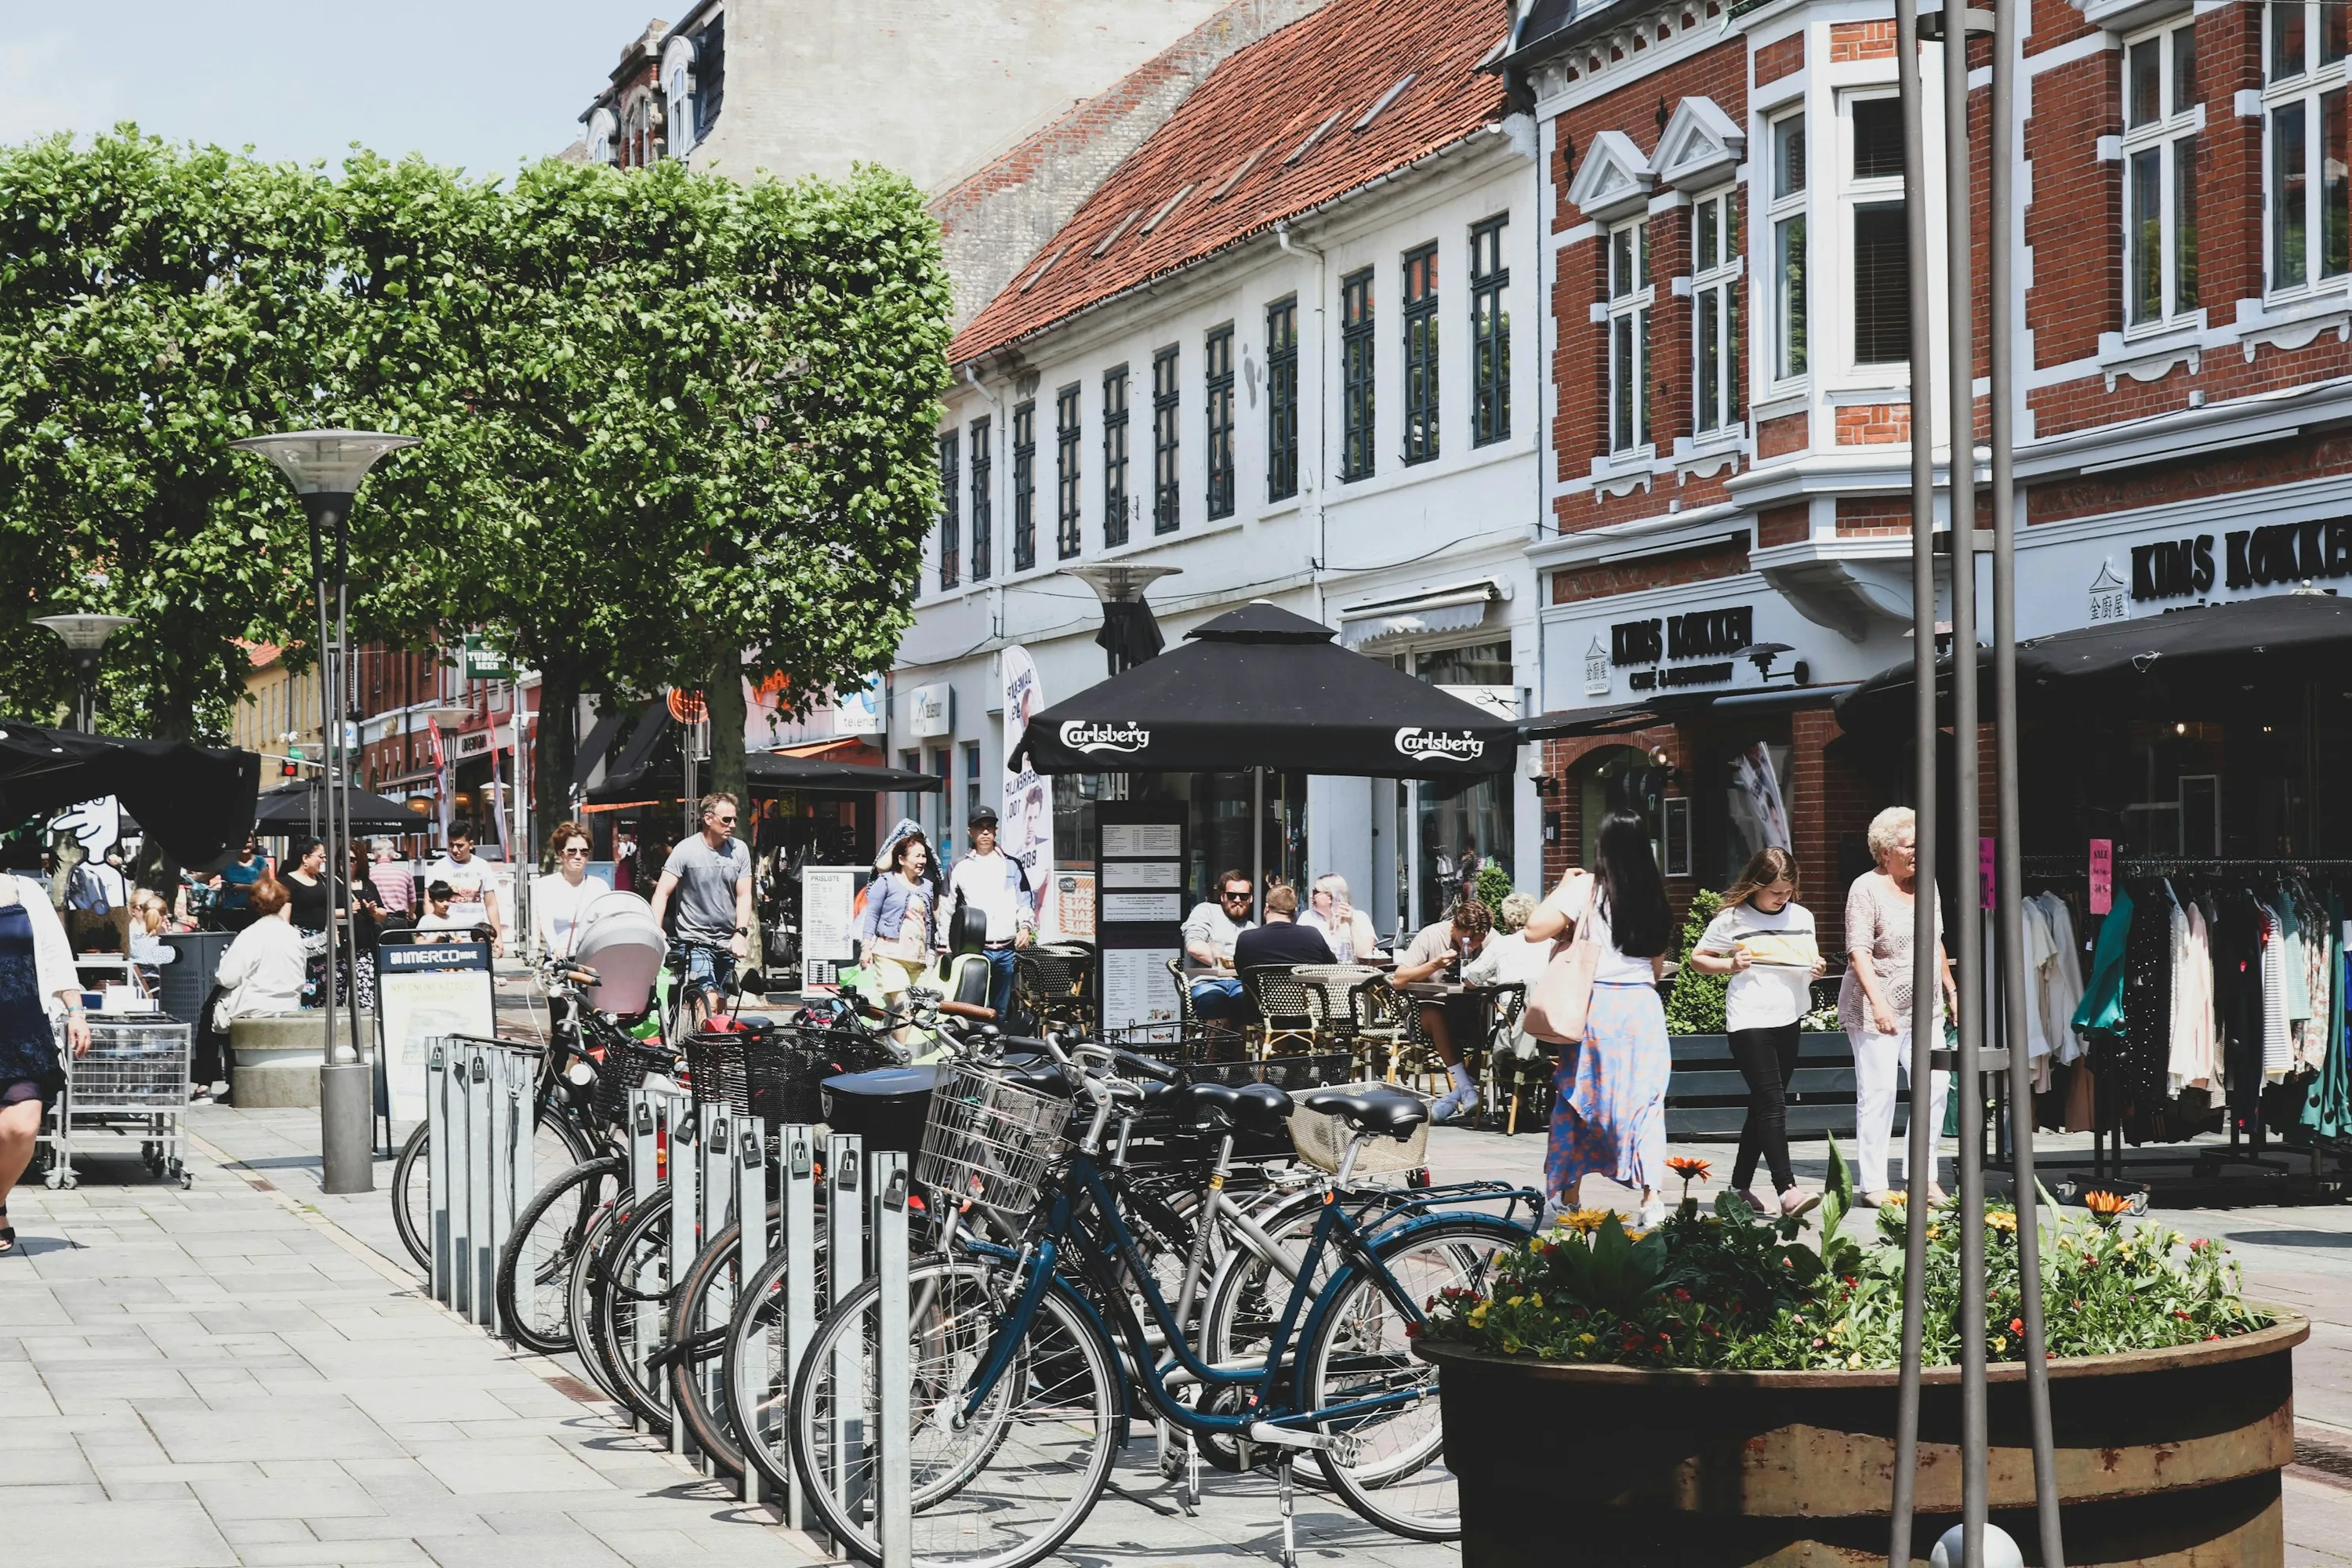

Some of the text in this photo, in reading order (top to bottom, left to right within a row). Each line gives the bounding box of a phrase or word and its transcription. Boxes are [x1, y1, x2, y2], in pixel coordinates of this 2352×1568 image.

[2131, 534, 2215, 601] KIMS
[475, 661, 499, 670] BEER
[844, 716, 880, 728] telenor
[1059, 720, 1150, 753] Carlsberg
[1395, 727, 1484, 761] Carlsberg
[1648, 793, 1656, 811] 17
[2093, 849, 2108, 859] SALE
[402, 949, 460, 964] IMERCO
[1192, 1215, 1210, 1265] EVERTON
